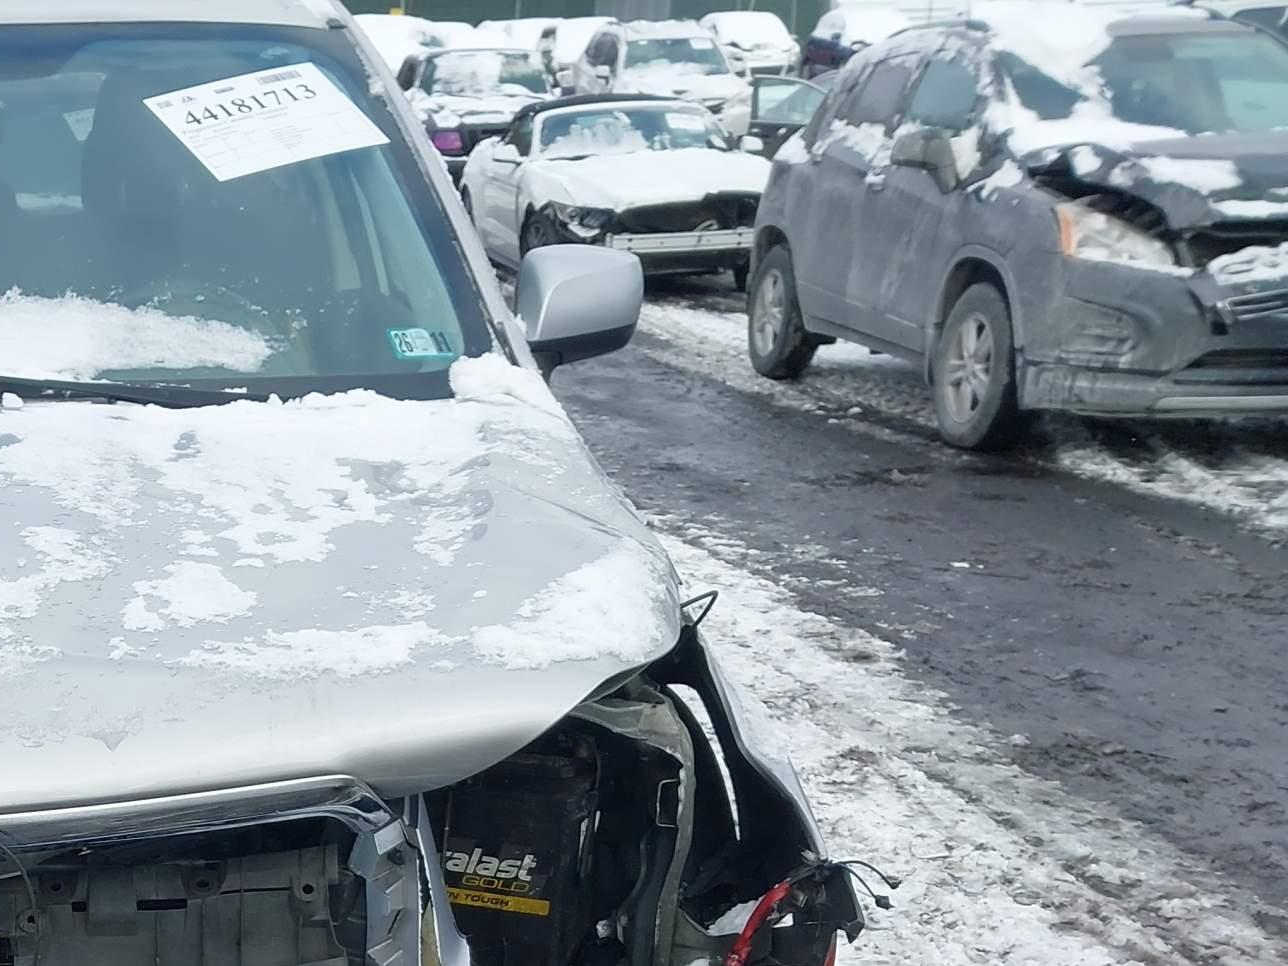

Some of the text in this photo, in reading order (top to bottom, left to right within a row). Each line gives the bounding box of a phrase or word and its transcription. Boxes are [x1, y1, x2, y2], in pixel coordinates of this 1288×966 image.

[185, 83, 317, 126] 44181713
[393, 331, 414, 353] 26
[462, 874, 530, 893] GOLD
[464, 893, 510, 906] TOUGH
